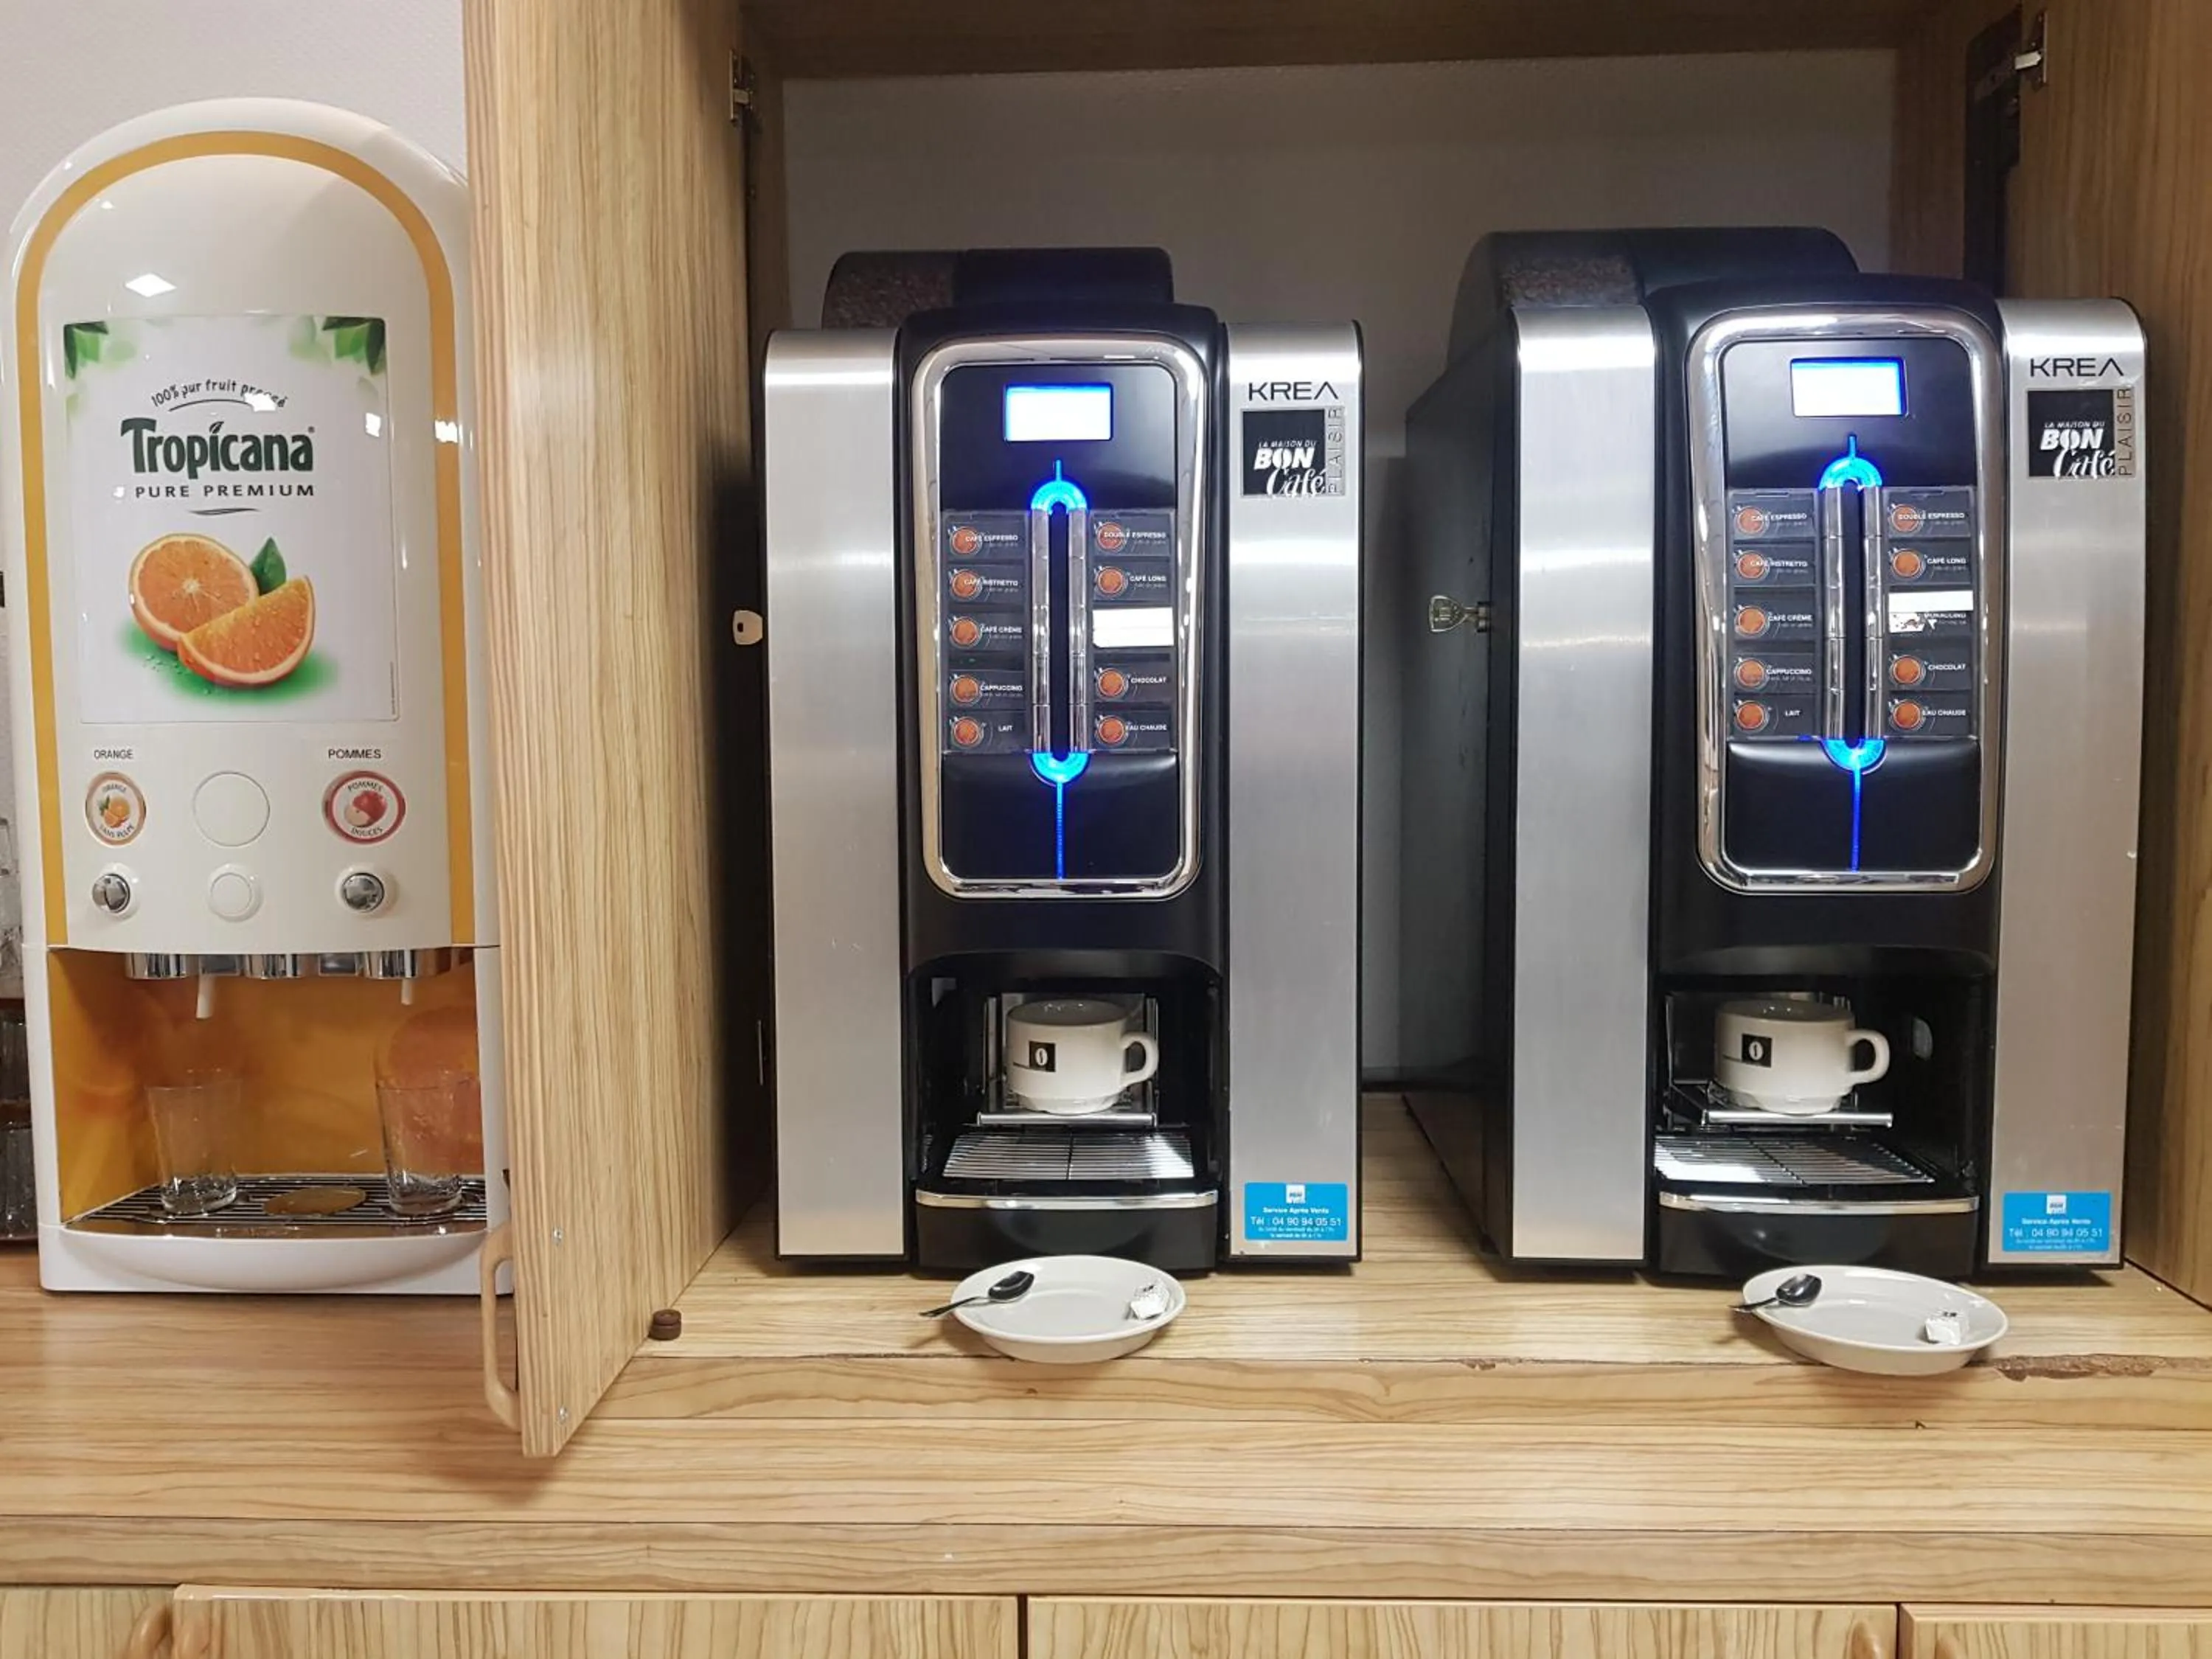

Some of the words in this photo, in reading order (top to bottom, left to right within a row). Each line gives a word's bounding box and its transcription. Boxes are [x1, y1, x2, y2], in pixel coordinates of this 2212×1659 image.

[151, 383, 179, 407] 100%
[182, 382, 202, 399] pur
[206, 379, 236, 392] fruit
[2039, 428, 2104, 451] BON
[2117, 388, 2132, 476] PLAISIR
[121, 417, 314, 479] Tropicana
[1270, 439, 1303, 448] MAISON
[1304, 439, 1317, 447] DU
[1328, 407, 1343, 493] PLAISIR
[1253, 448, 1315, 470] BON
[135, 486, 189, 498] PURE
[204, 484, 314, 497] PREMIUM
[1266, 467, 1326, 499] Café
[94, 748, 133, 759] ORANGE
[327, 748, 381, 759] POMMES
[347, 780, 383, 792] POMMES
[1272, 1217, 1284, 1225] 04
[1329, 1217, 1341, 1226] 51
[2031, 1228, 2043, 1237] 04
[2091, 1228, 2102, 1237] 51
